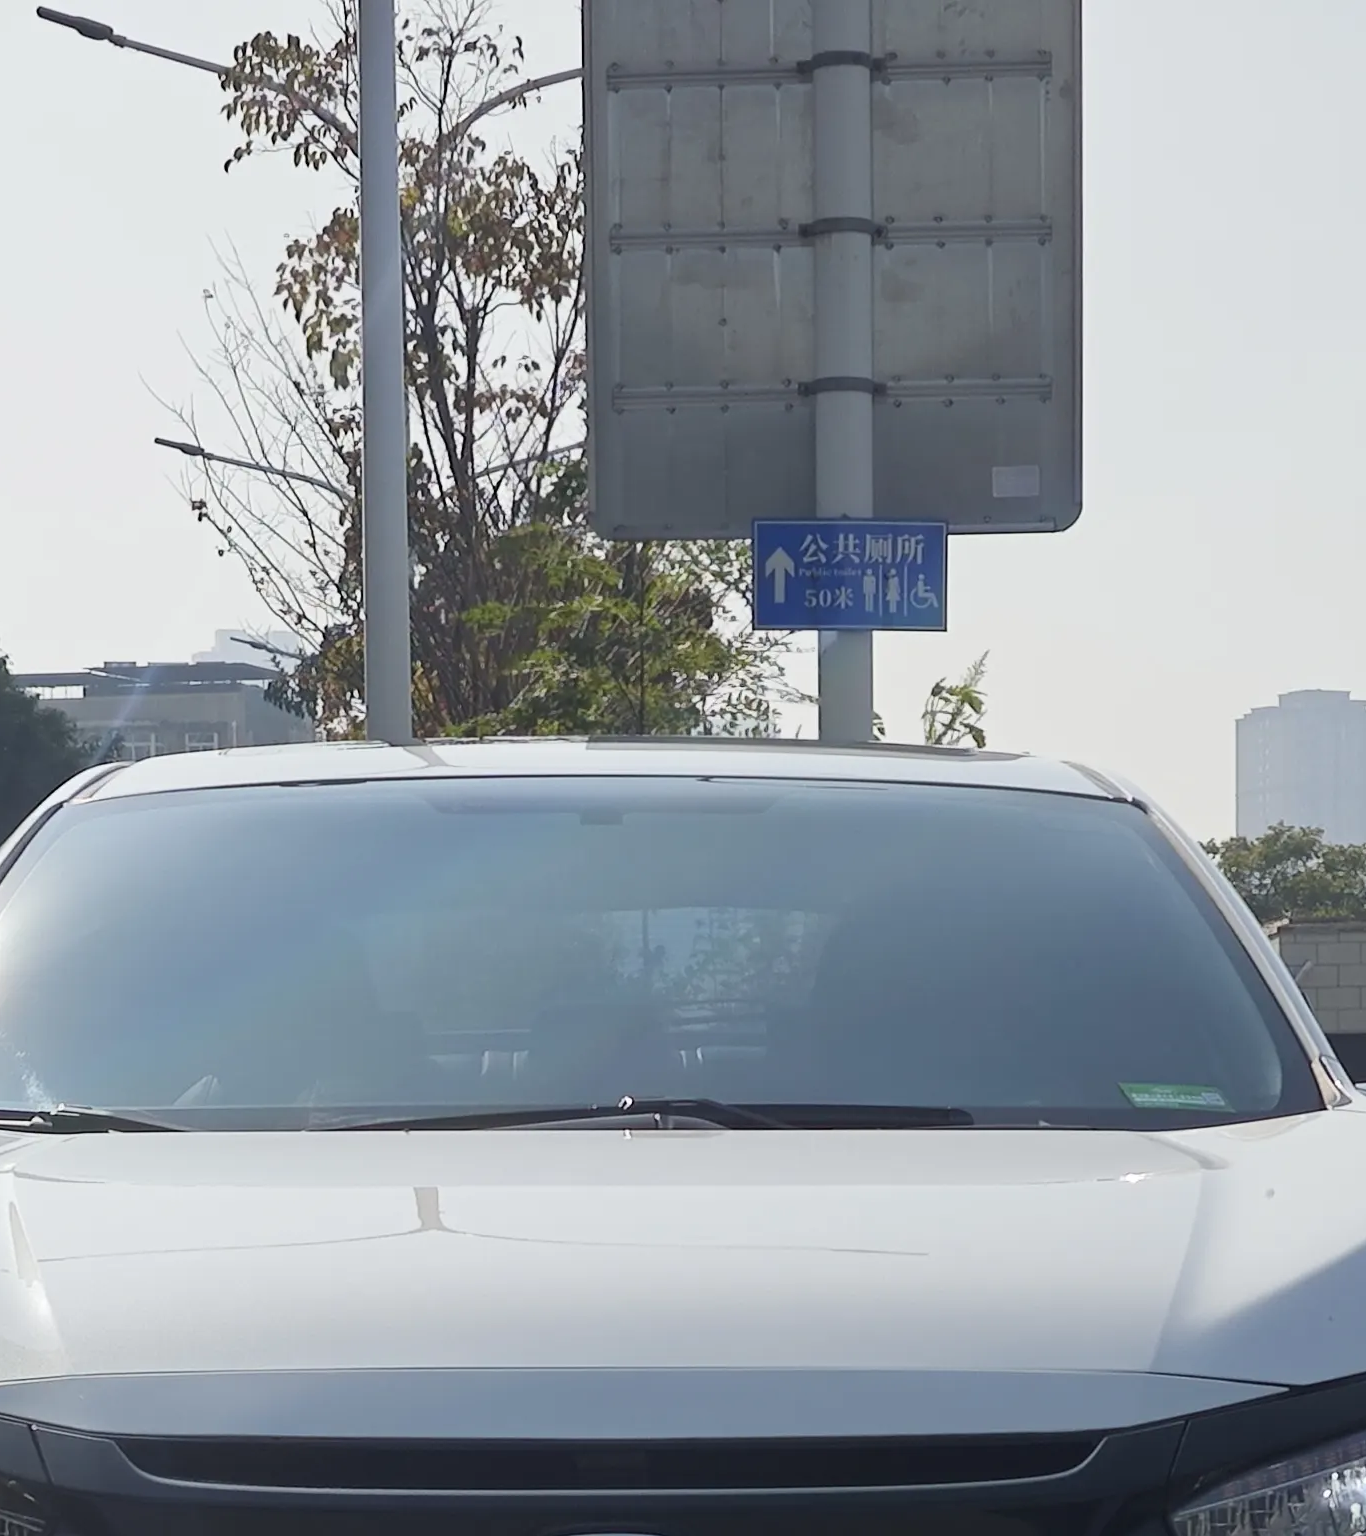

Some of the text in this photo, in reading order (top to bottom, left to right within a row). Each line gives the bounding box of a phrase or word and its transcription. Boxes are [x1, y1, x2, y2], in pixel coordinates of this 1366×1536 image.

[799, 533, 925, 565] 公共厕所
[804, 586, 854, 609] 50米
